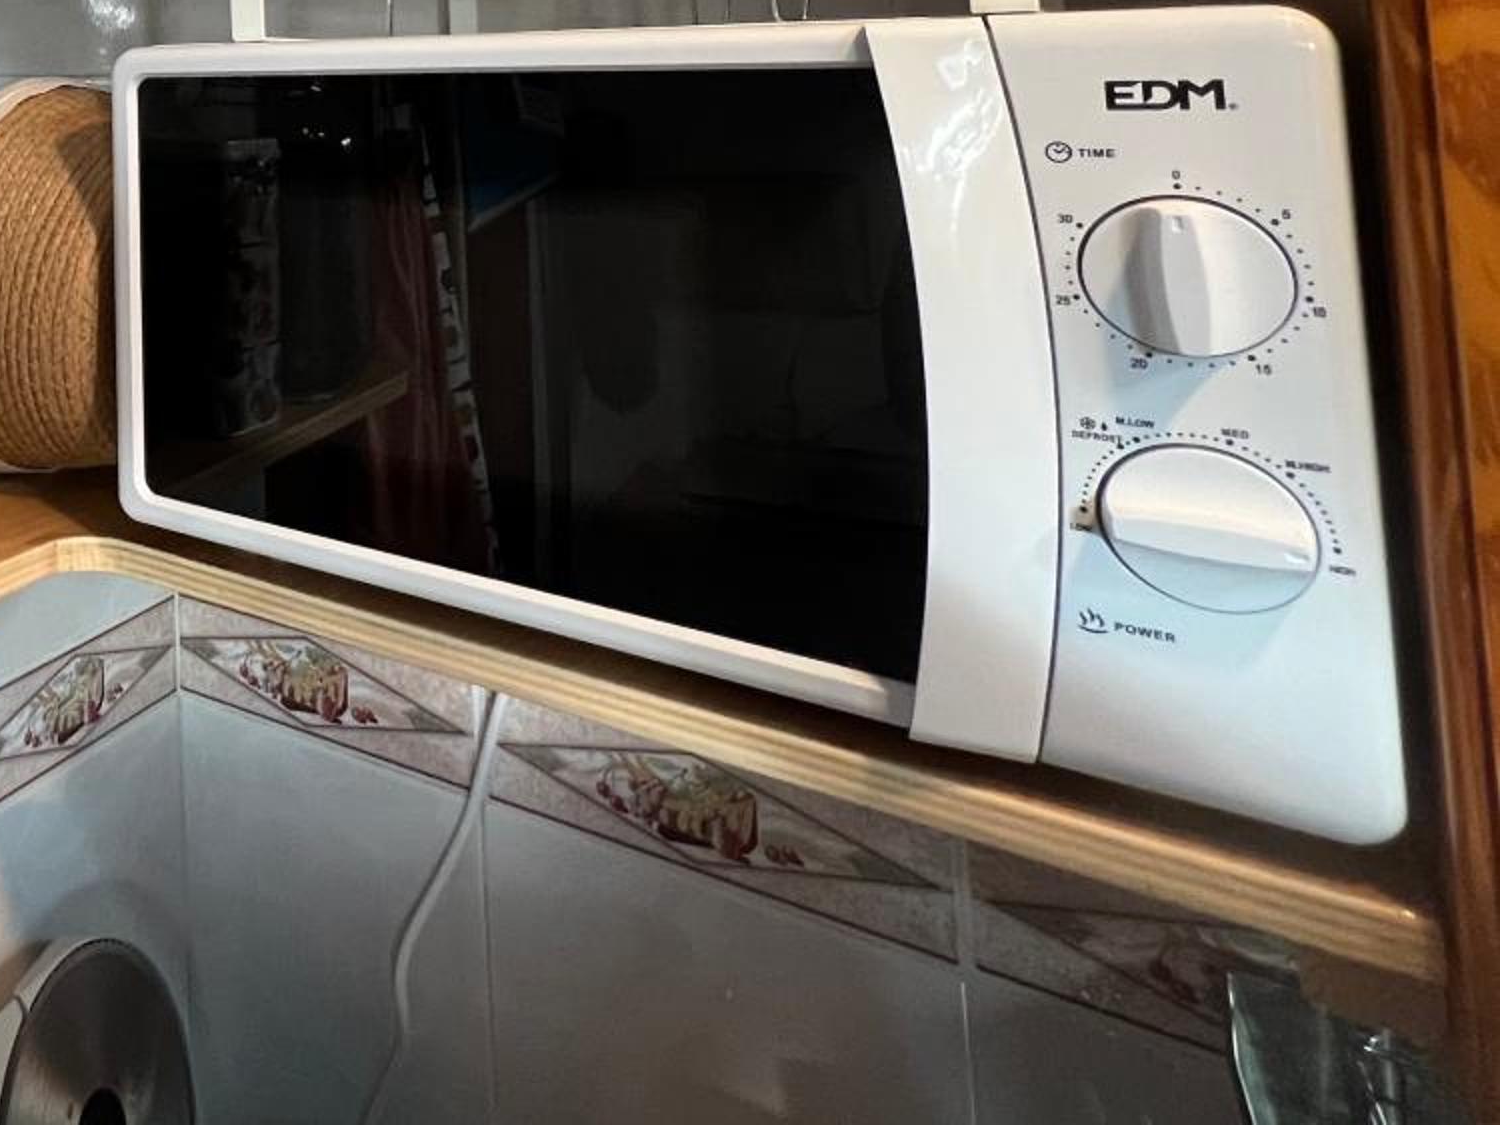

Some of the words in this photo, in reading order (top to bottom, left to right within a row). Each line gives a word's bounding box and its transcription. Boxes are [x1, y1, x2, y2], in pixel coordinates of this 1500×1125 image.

[1104, 79, 1227, 111] EDM
[1078, 148, 1116, 159] TIME
[1171, 170, 1181, 180] 0
[1058, 214, 1073, 224] 30
[1281, 209, 1291, 220] 5
[1055, 295, 1071, 306] 25
[1312, 306, 1327, 318] 10
[1130, 358, 1148, 369] 20
[1256, 364, 1272, 375] 15
[1221, 427, 1250, 440] MED
[1113, 621, 1177, 644] POWER
